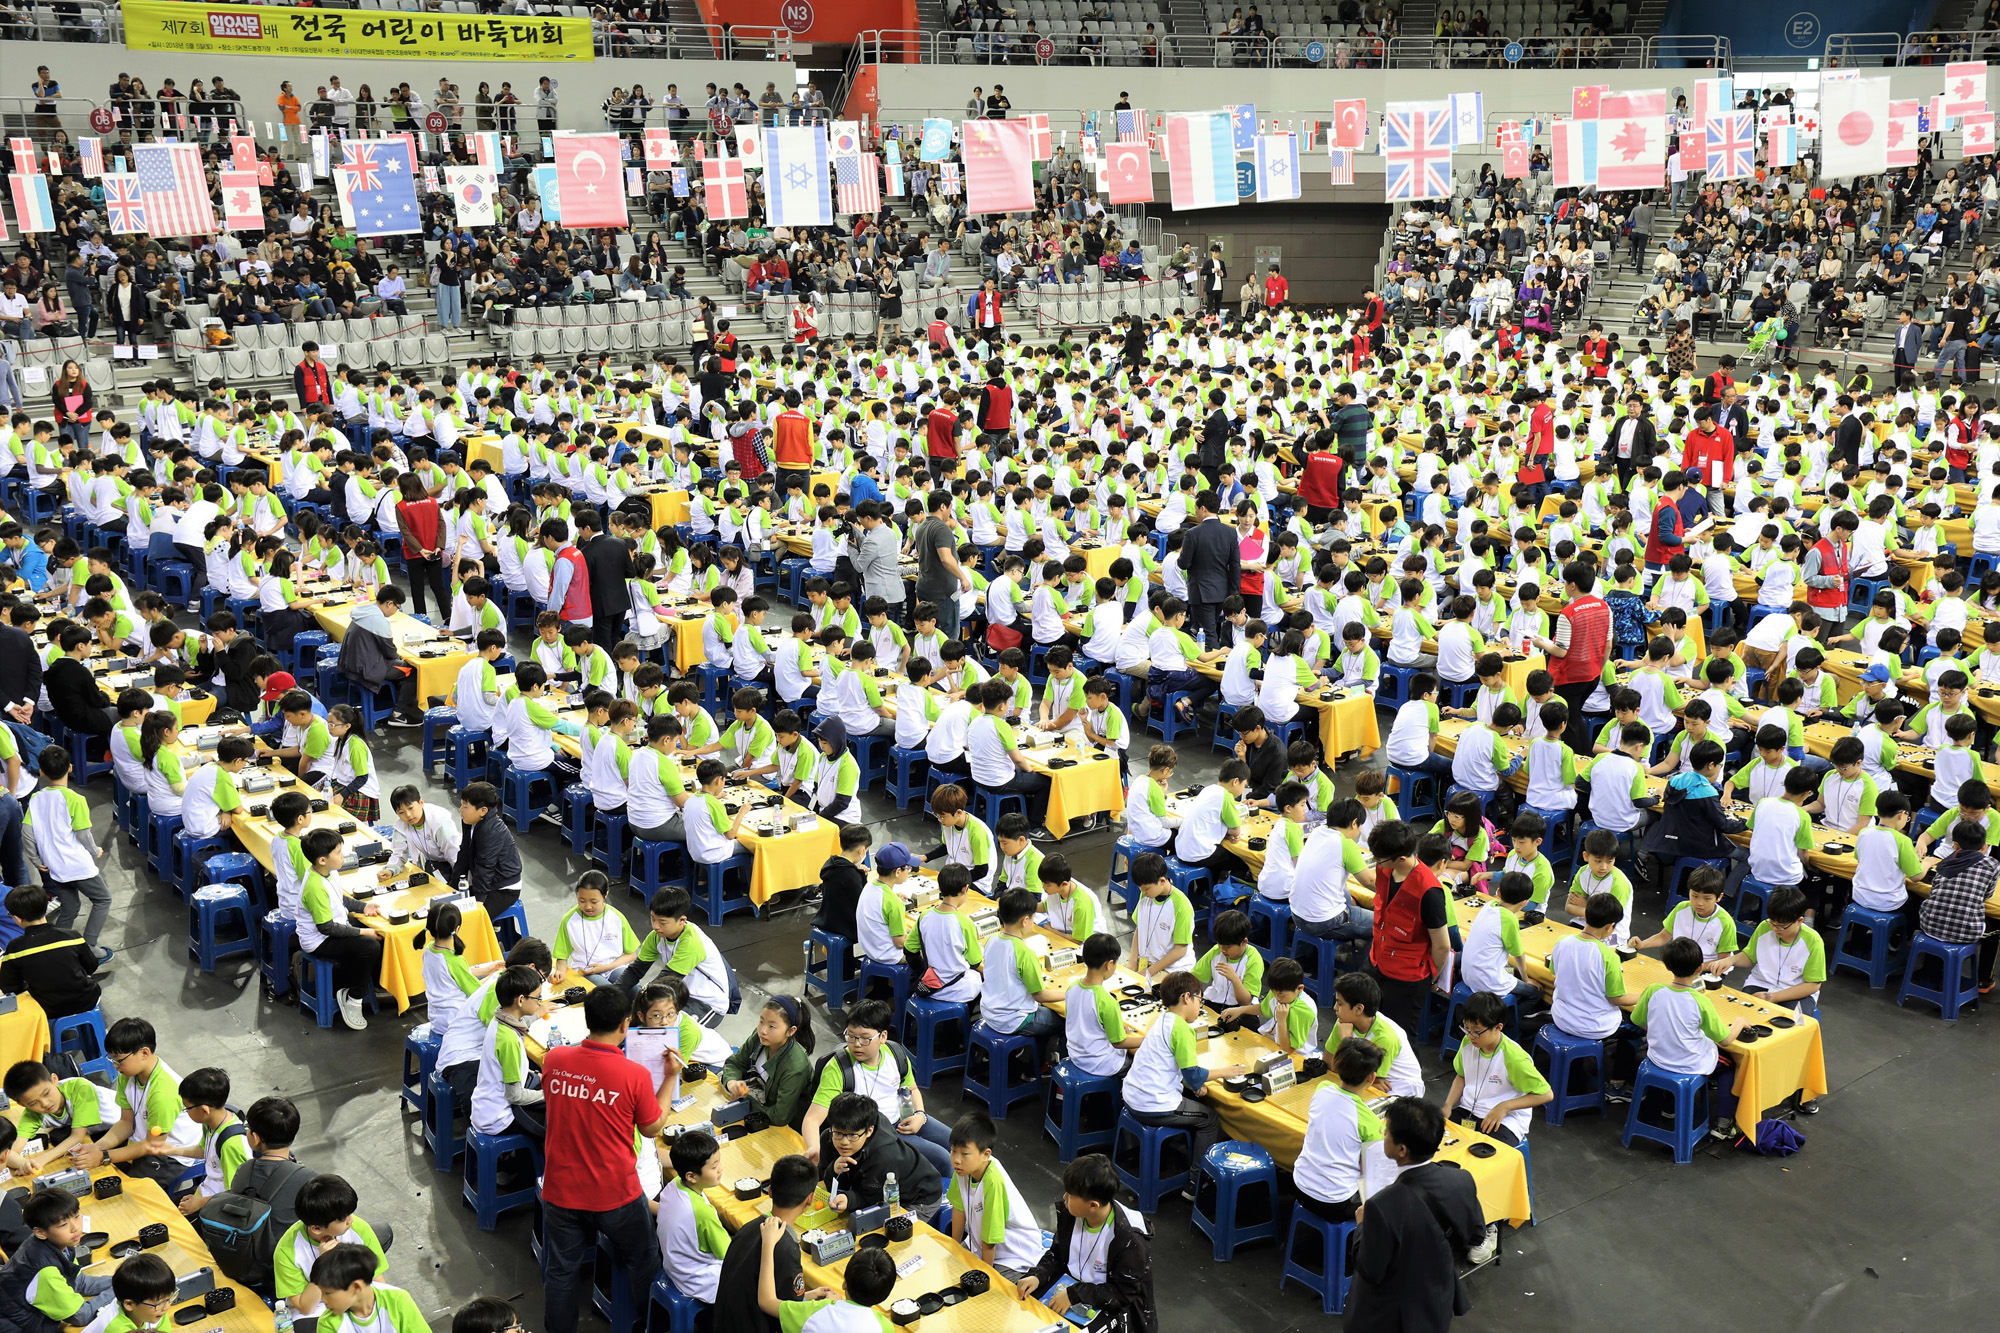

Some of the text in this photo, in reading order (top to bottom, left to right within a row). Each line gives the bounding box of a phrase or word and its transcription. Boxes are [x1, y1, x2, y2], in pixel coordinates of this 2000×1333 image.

[787, 6, 808, 20] N3
[161, 14, 563, 48] 제7회 일요신문 배 전국 어린이 바둑대회
[1793, 21, 1814, 35] E2
[1040, 44, 1050, 52] 39
[1310, 47, 1320, 55] 40
[1509, 48, 1518, 56] 41
[430, 118, 443, 128] 09
[719, 120, 728, 129] 10
[1238, 170, 1252, 184] E1
[561, 1070, 572, 1078] One
[584, 1075, 597, 1084] Only
[550, 1079, 620, 1106] Club A7
